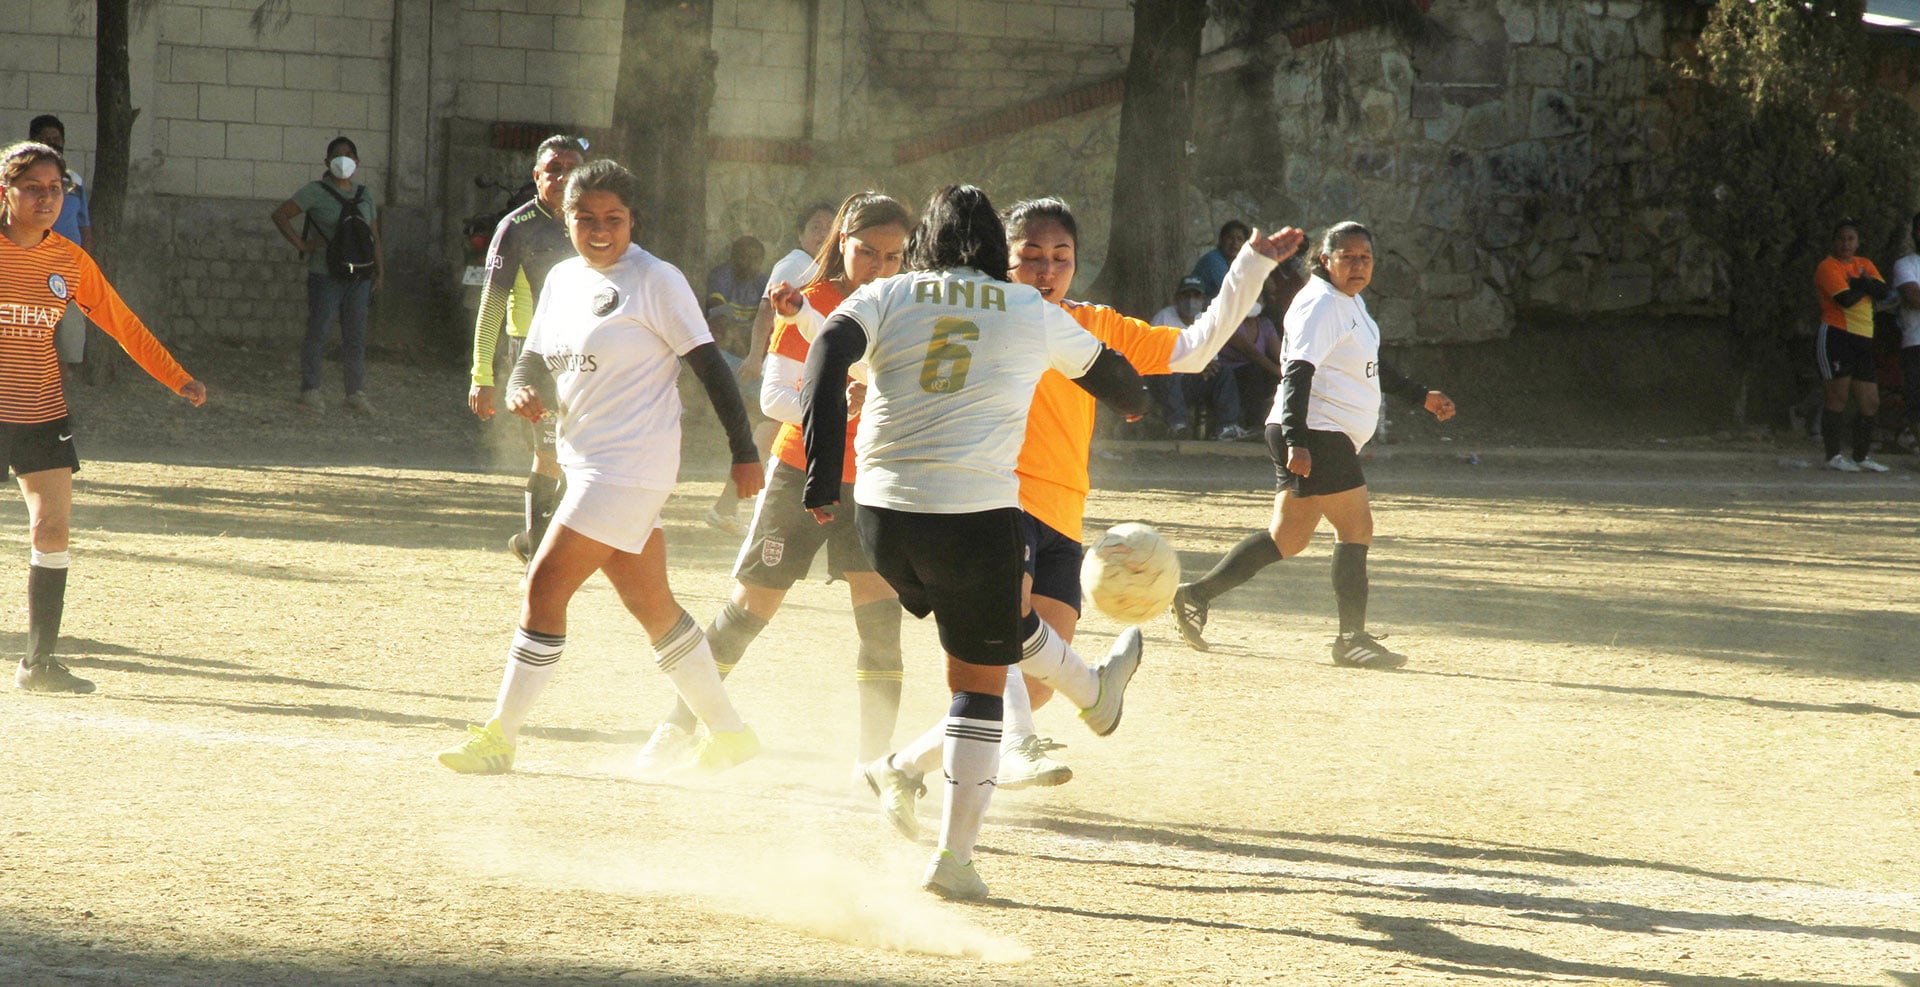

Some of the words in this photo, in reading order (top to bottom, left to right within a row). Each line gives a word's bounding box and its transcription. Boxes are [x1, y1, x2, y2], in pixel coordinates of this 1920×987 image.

[915, 281, 1007, 312] ANA
[0, 304, 60, 328] ETIHAD
[919, 316, 980, 393] 6
